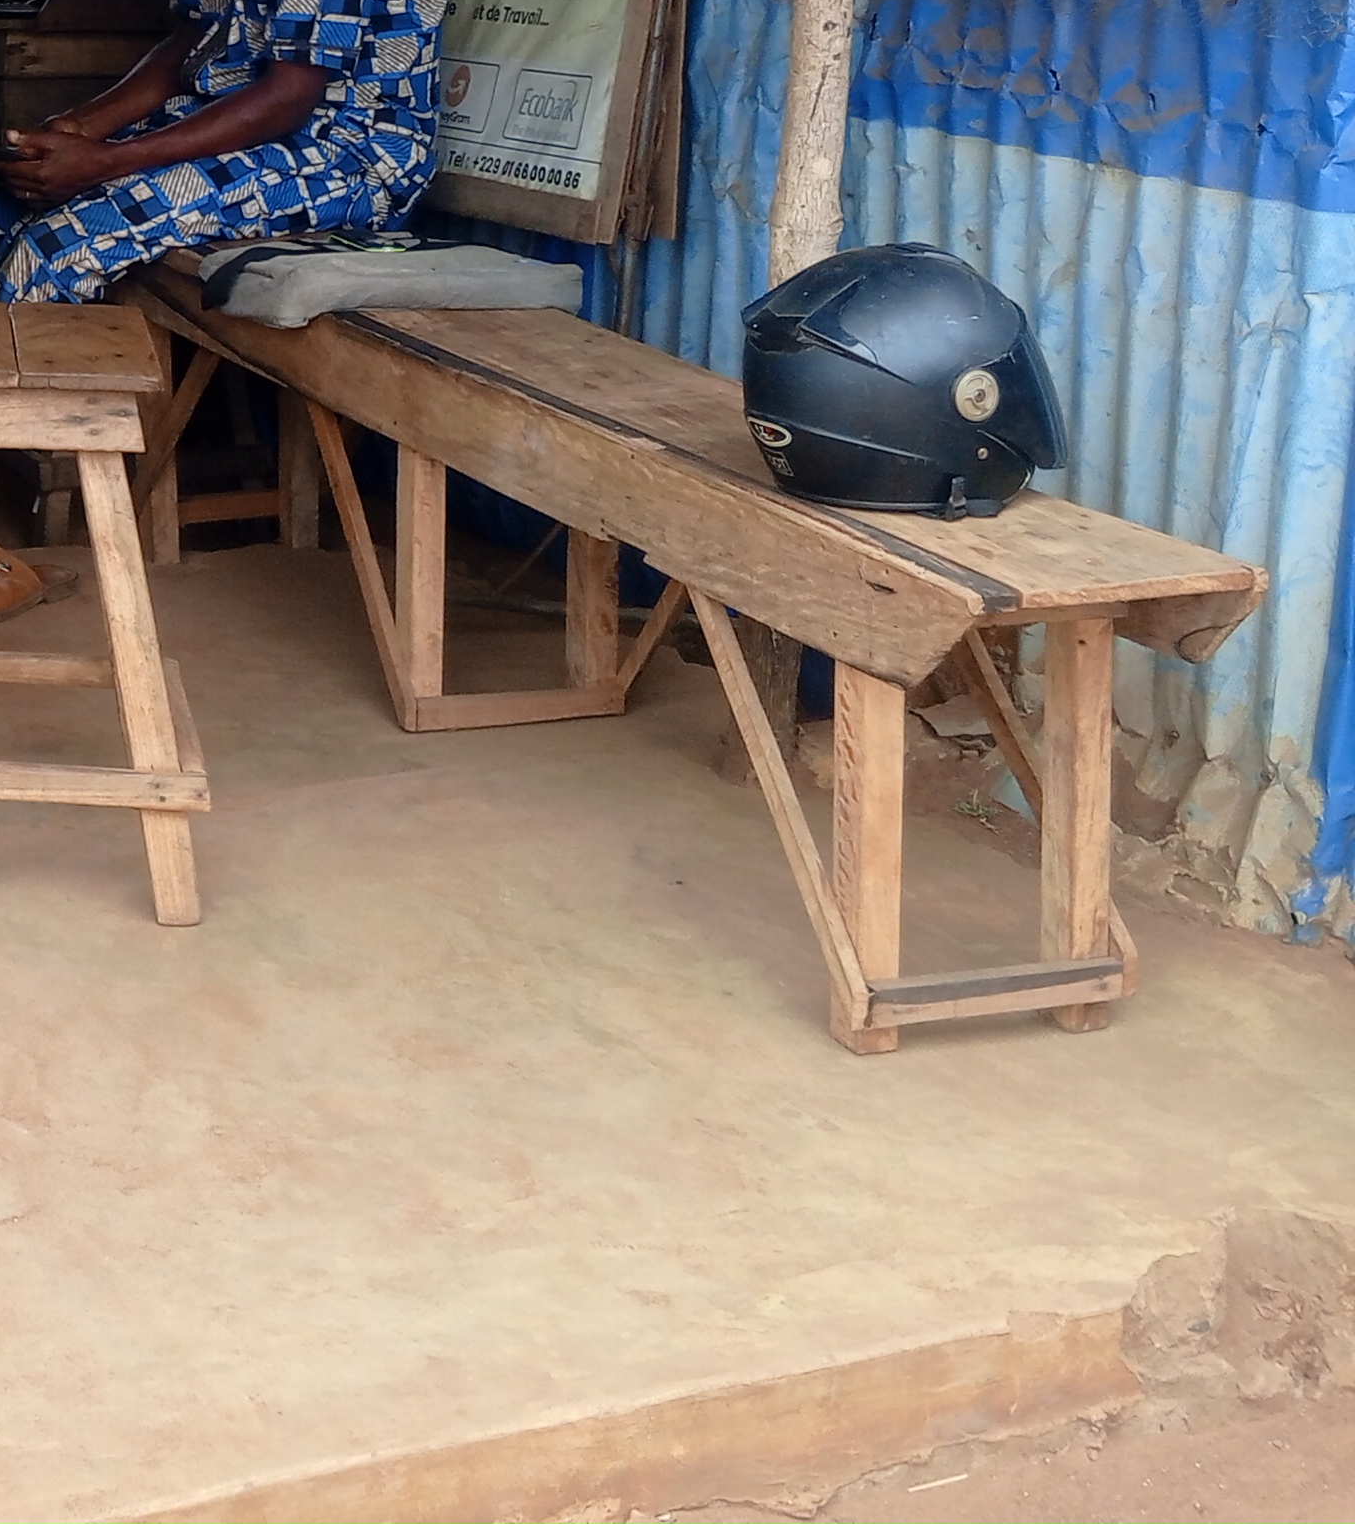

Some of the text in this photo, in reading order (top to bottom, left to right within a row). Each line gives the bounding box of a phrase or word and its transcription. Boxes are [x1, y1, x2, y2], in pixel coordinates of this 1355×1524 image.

[486, 6, 501, 22] de
[518, 87, 580, 123] Ecobank
[563, 169, 582, 189] 86
